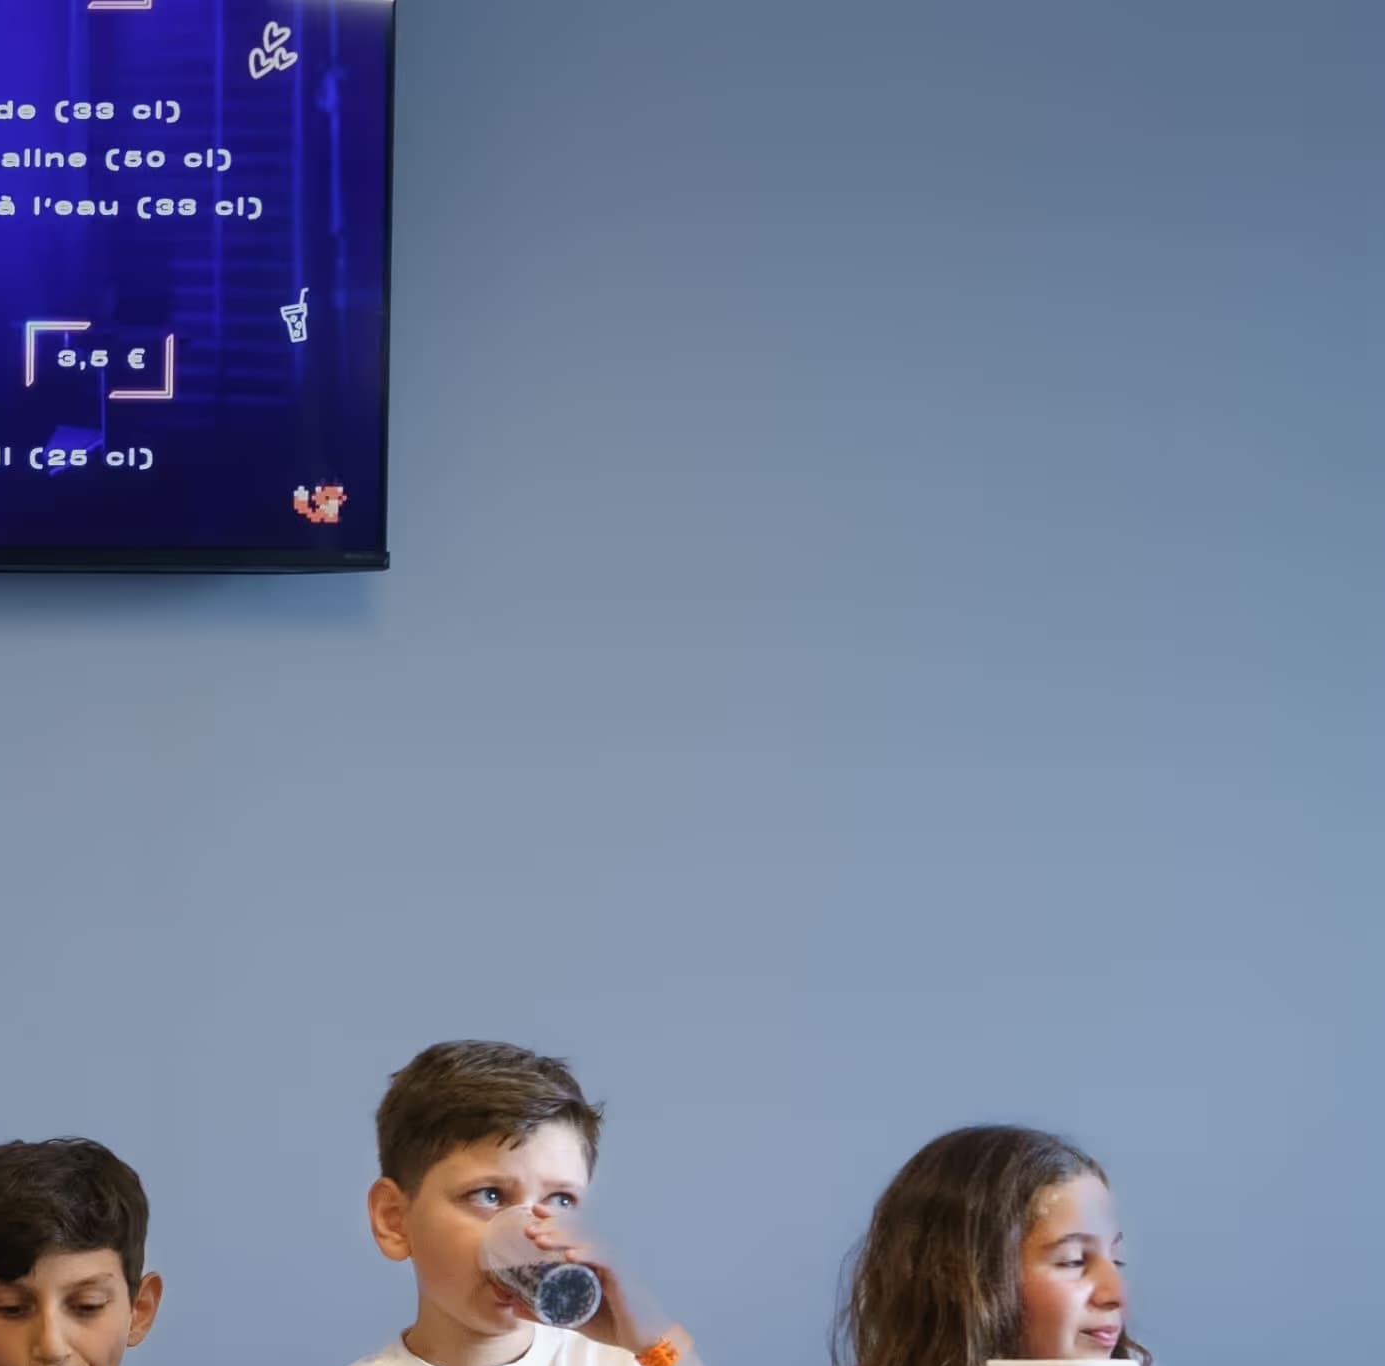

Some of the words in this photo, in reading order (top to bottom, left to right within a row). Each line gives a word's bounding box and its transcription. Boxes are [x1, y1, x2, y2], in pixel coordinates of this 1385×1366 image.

[54, 100, 115, 124] (33
[132, 100, 181, 124] cl)
[105, 148, 166, 172] (50
[183, 148, 232, 172] cl)
[33, 196, 119, 216] l'eau
[136, 196, 197, 220] (33
[215, 196, 263, 220] cl)
[57, 349, 109, 371] 3,5
[127, 347, 146, 369] €
[29, 447, 88, 470] (25
[106, 447, 153, 470] cl)
